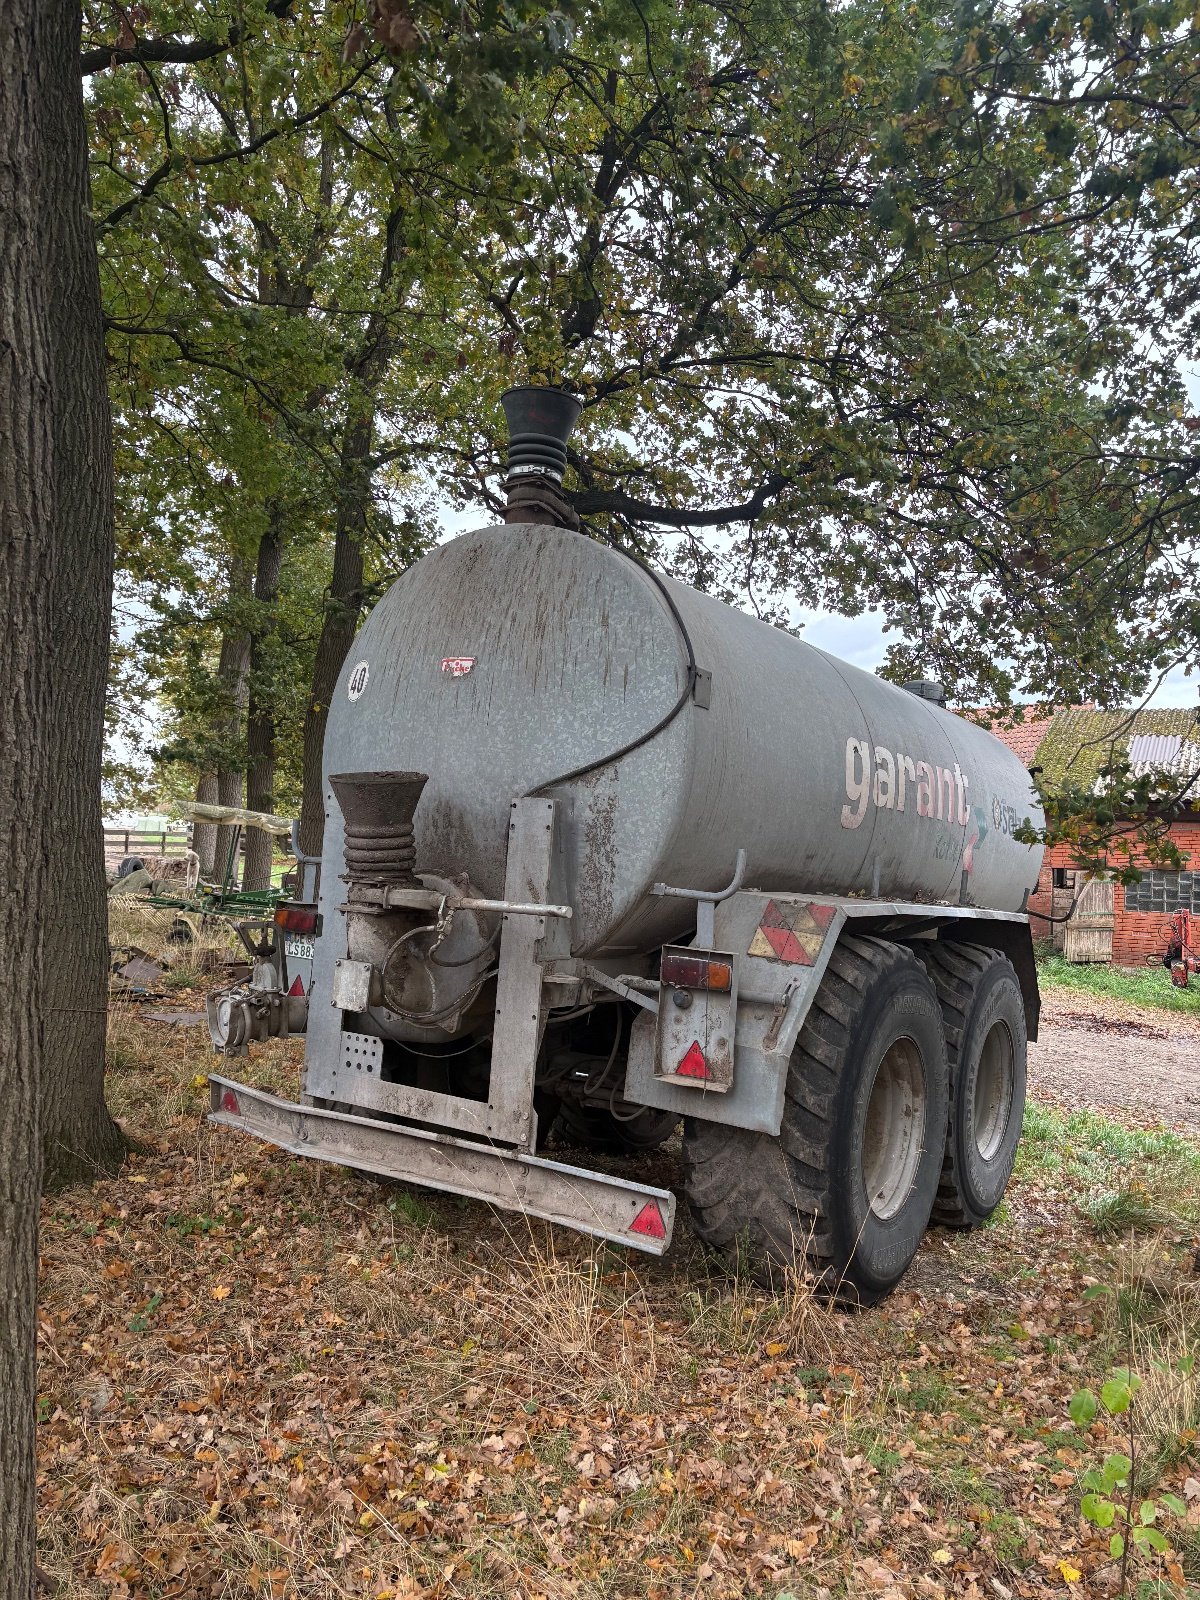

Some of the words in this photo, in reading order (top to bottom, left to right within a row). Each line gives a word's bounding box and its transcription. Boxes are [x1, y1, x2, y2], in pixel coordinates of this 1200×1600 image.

[350, 666, 367, 694] 40
[840, 736, 971, 830] garant
[288, 944, 300, 956] LS
